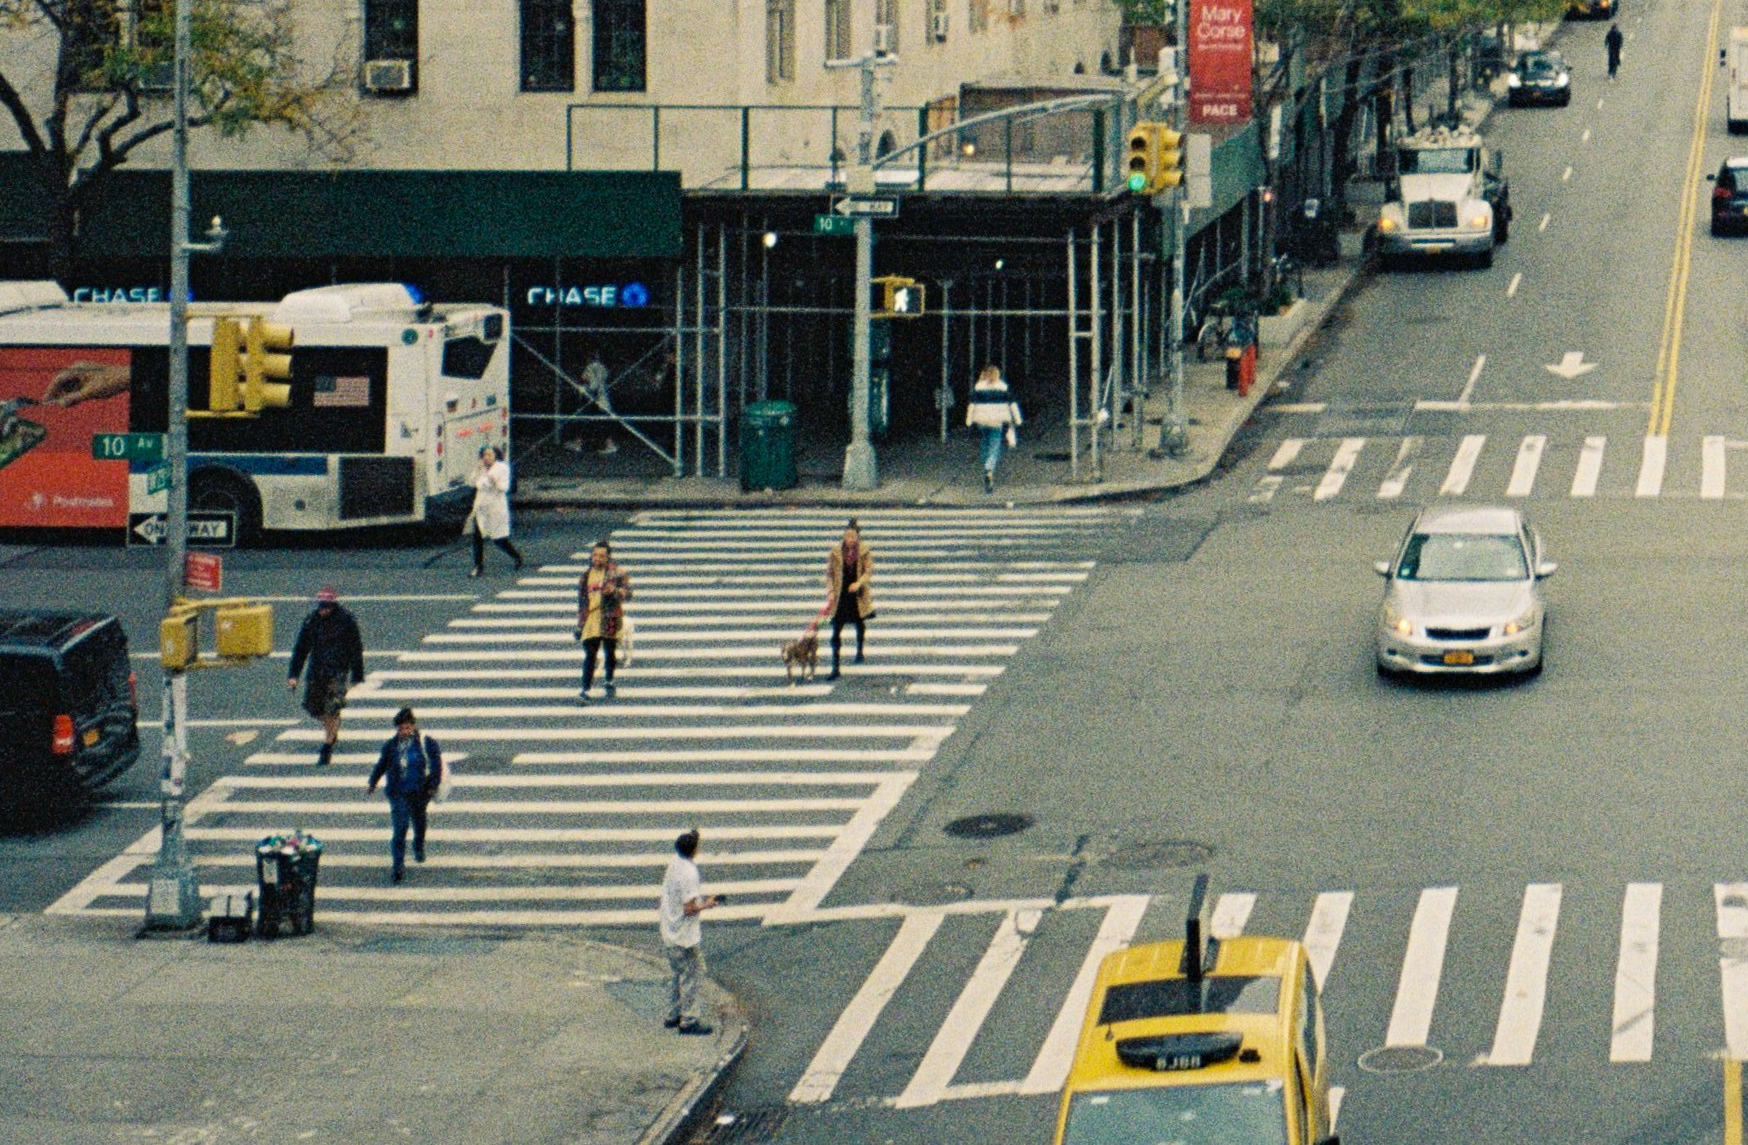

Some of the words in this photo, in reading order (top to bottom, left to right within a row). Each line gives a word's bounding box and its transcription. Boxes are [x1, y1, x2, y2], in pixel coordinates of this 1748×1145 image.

[1201, 6, 1242, 24] Mary
[1197, 23, 1246, 39] Corse
[1202, 105, 1238, 116] PACE
[820, 217, 833, 231] 10
[73, 287, 161, 303] CHASE
[527, 287, 616, 304] CHASE
[102, 436, 125, 456] 10
